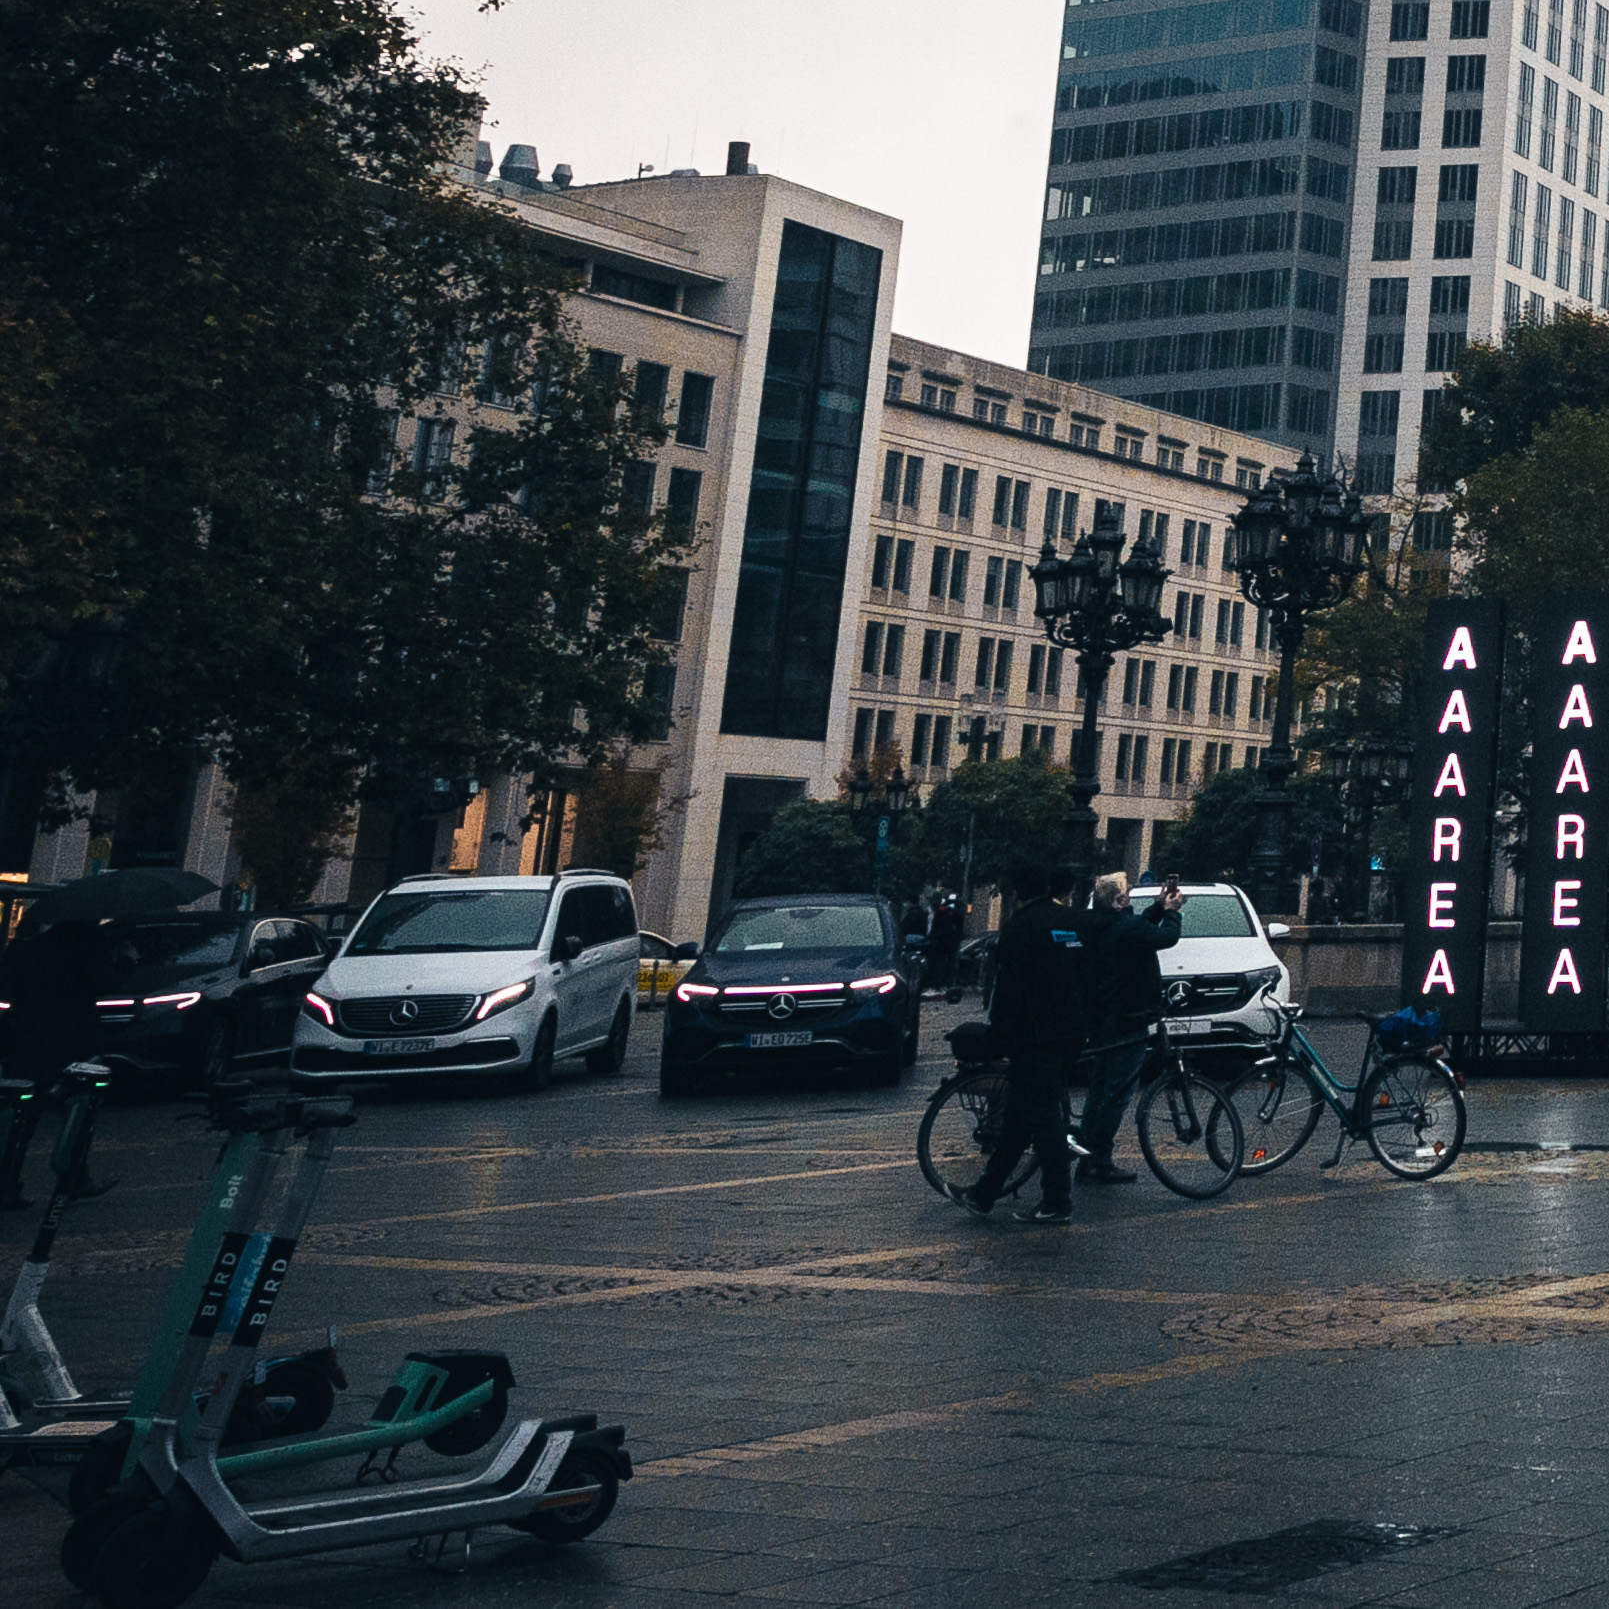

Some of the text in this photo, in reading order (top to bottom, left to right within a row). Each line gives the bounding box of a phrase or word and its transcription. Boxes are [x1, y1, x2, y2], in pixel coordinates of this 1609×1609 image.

[42, 1193, 68, 1230] Lime
[219, 1173, 244, 1210] Bolt
[200, 1251, 237, 1318] BIRD
[248, 1257, 288, 1326] BIRD
